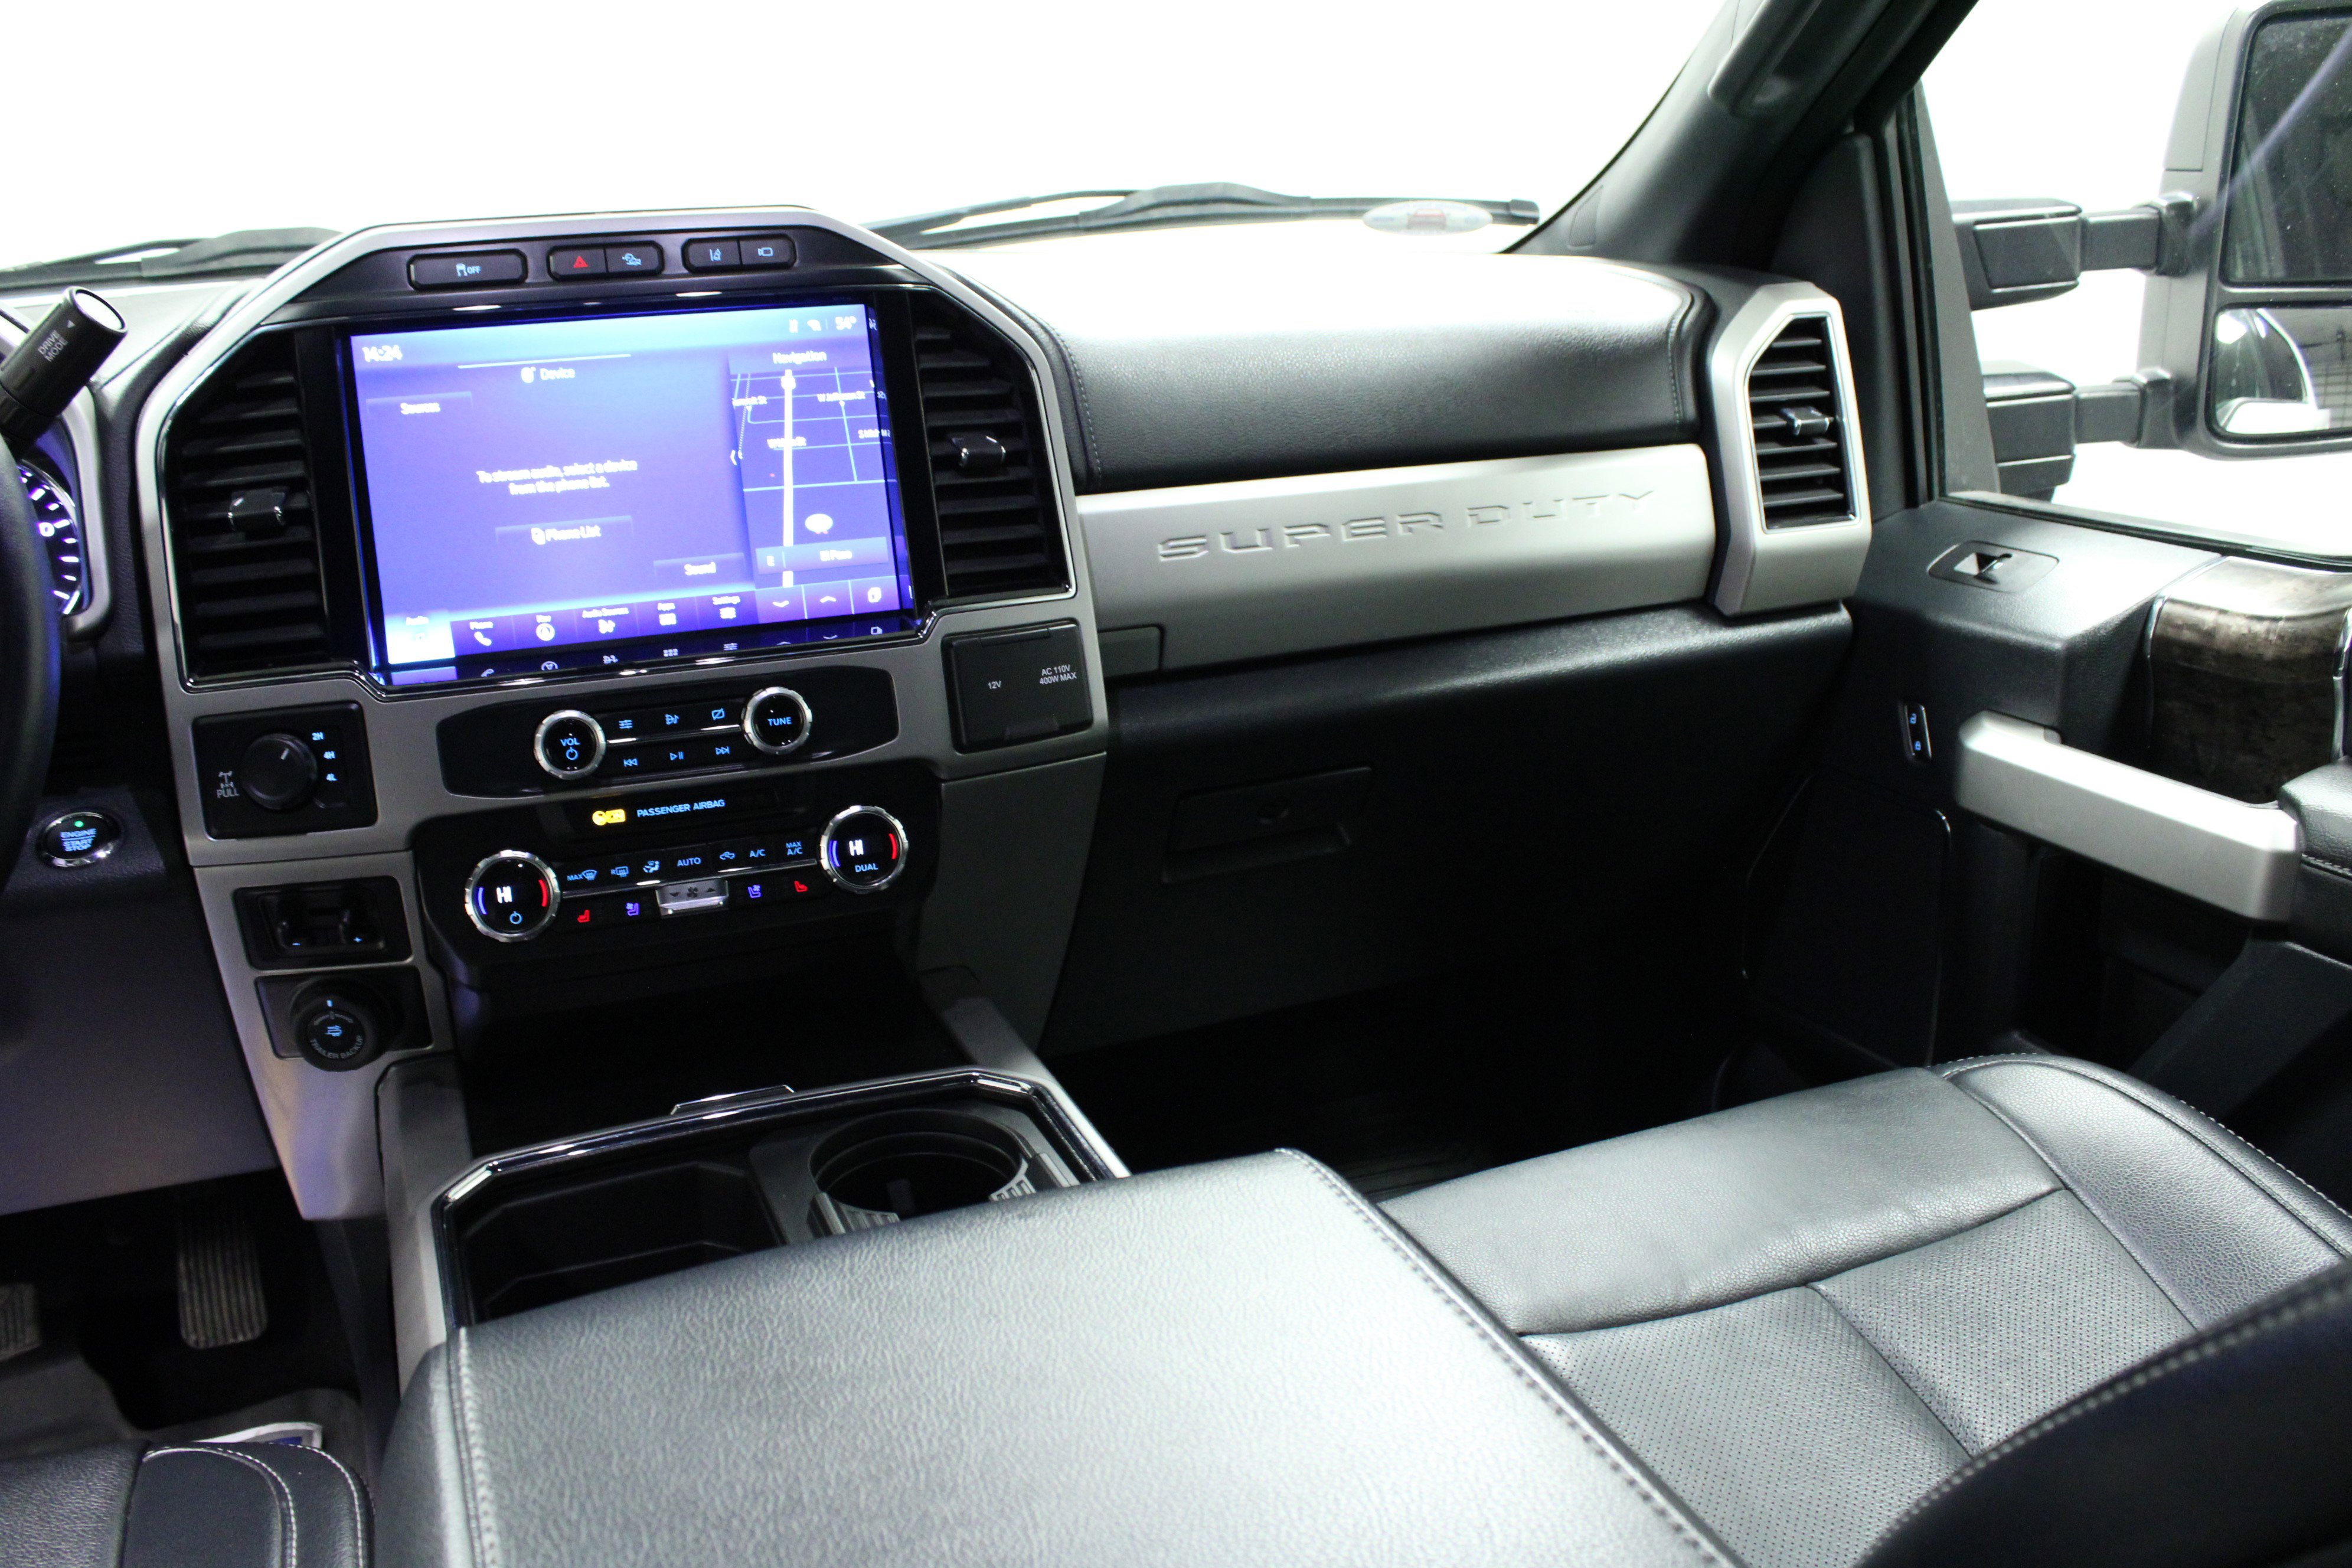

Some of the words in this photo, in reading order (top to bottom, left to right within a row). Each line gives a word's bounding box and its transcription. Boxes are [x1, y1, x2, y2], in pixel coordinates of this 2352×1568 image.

[467, 266, 481, 274] OFF
[38, 330, 61, 354] DRIVE
[44, 337, 68, 362] MODE
[773, 351, 827, 364] Navigation
[540, 367, 575, 380] Device
[476, 471, 492, 484] To
[595, 463, 603, 473] a
[603, 459, 638, 473] device
[508, 483, 536, 495] from
[536, 481, 555, 493] the
[555, 479, 589, 493] phone
[546, 527, 579, 541] Phone
[580, 525, 601, 538] List
[1158, 511, 1444, 562] SUPER
[1467, 491, 1654, 527] DUTY
[684, 562, 716, 575] Sound
[1041, 667, 1053, 676] AC
[1053, 664, 1071, 674] 110V
[988, 680, 1002, 690] 12V
[1039, 675, 1059, 685] 400W
[1060, 672, 1077, 682] MAX
[767, 716, 793, 726] TUNE
[560, 737, 580, 747] VOL
[216, 789, 239, 798] PULL
[636, 803, 690, 818] PASSENGER
[692, 799, 727, 811] AIRBAG
[60, 828, 96, 838] ENGINE
[63, 838, 93, 847] START
[785, 841, 802, 849] MAX
[848, 839, 864, 856] HI
[749, 848, 766, 858] A/C
[786, 847, 803, 855] A/C
[677, 857, 701, 867] AUTO
[854, 863, 879, 873] DUAL
[496, 886, 513, 904] HI
[309, 1038, 339, 1059] TRAILER
[340, 1035, 364, 1059] BACKUP
